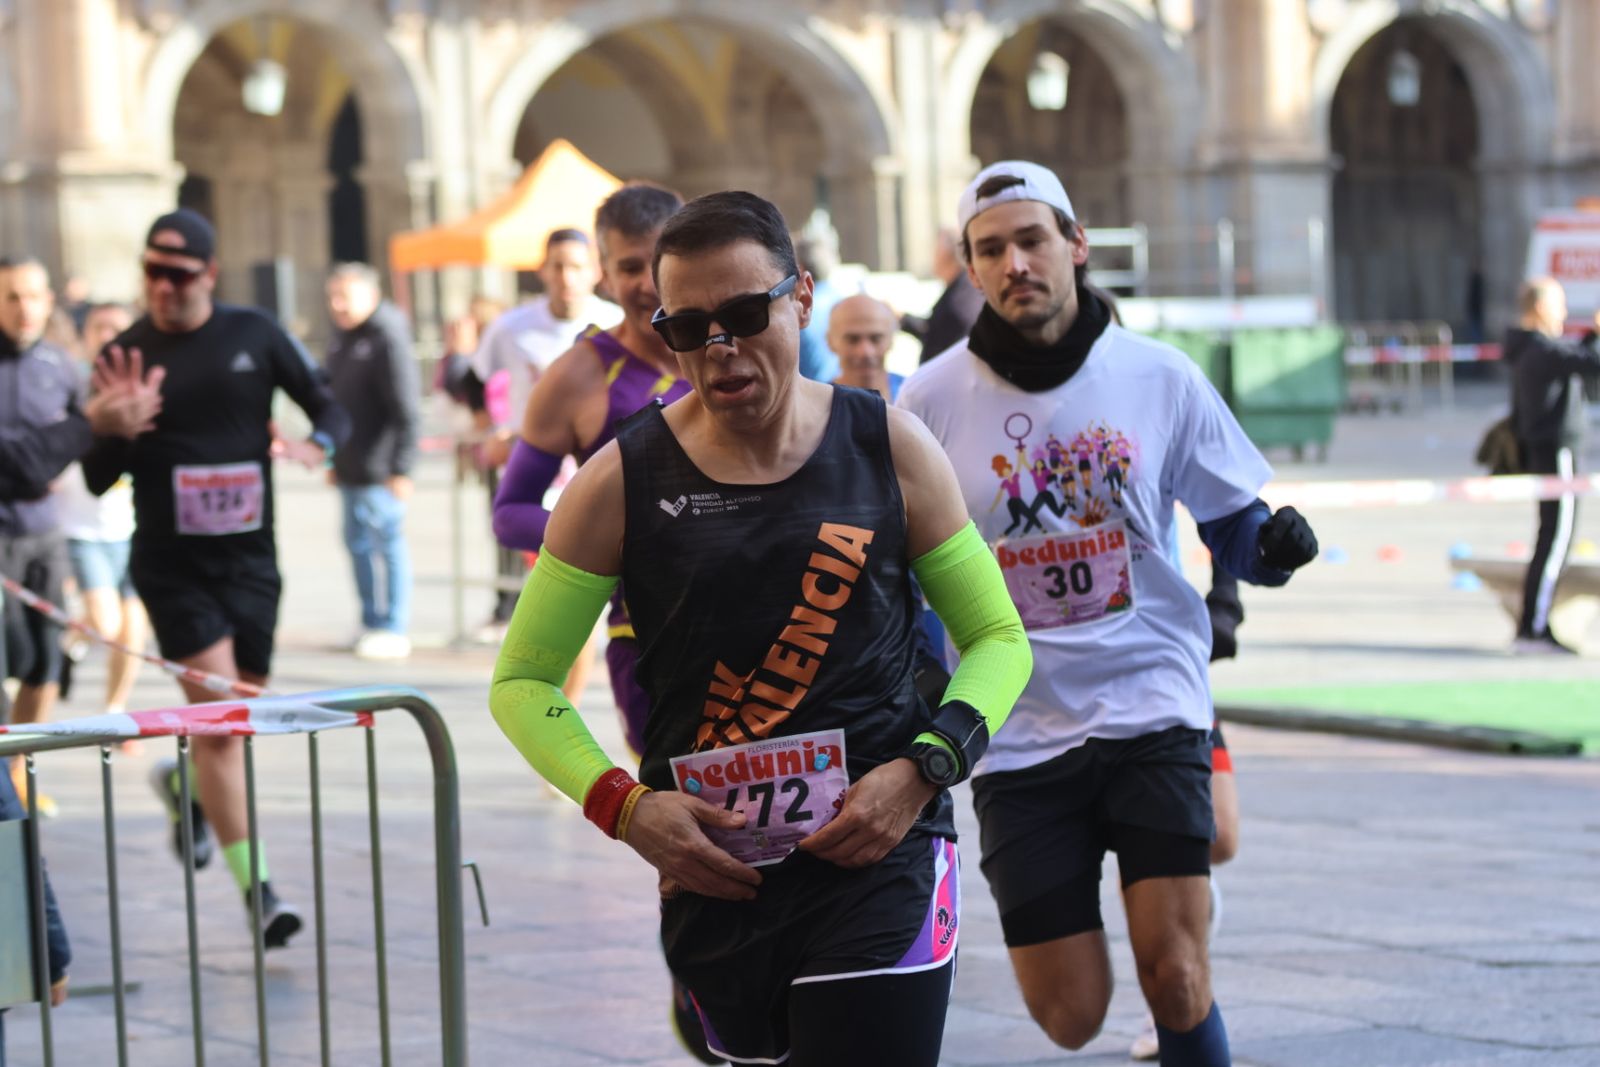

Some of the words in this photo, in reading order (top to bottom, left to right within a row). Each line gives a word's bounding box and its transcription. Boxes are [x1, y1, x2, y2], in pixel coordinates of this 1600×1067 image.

[689, 492, 720, 501] VALENCIA
[725, 495, 762, 504] ALFONSO
[996, 529, 1126, 569] bedunia
[1043, 561, 1094, 599] 30
[747, 739, 800, 754] FLORISTERÍAS
[676, 741, 842, 794] bedunia
